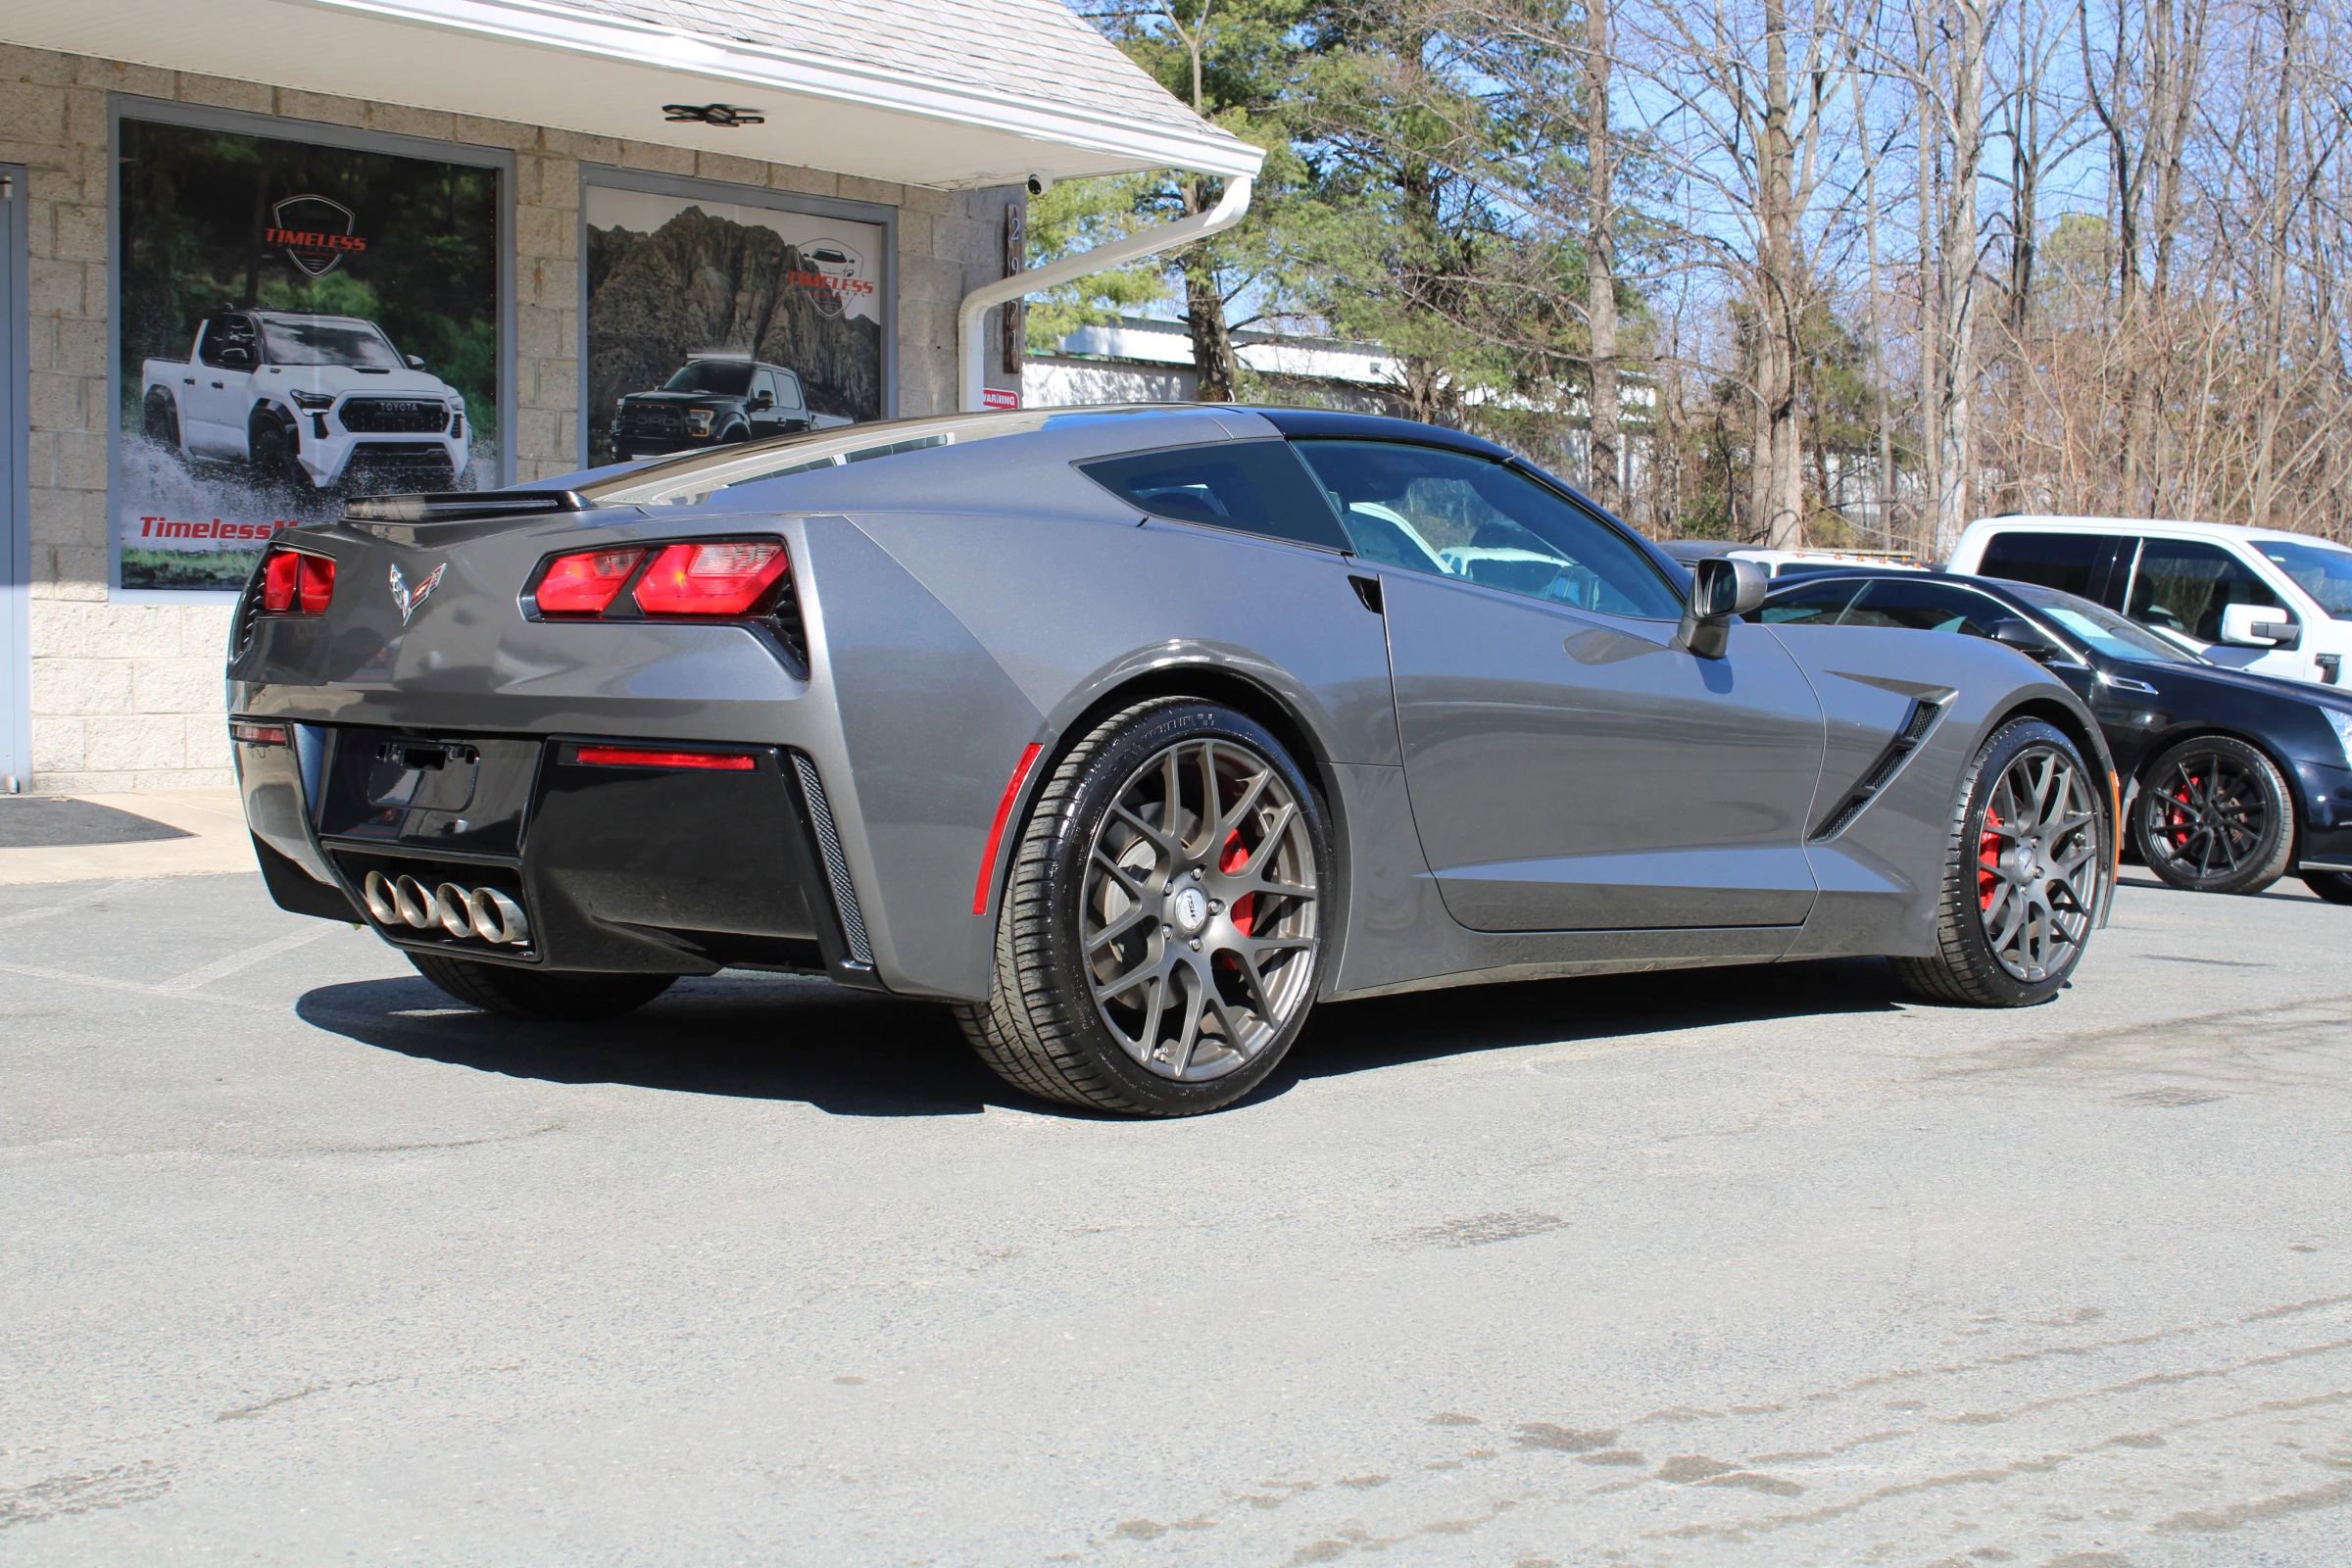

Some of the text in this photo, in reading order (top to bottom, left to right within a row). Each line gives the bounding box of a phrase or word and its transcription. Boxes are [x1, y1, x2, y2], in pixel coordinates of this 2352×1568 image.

[266, 228, 367, 252] TIMELESS
[788, 270, 874, 294] TIMELESS
[380, 402, 417, 412] TOYOTA
